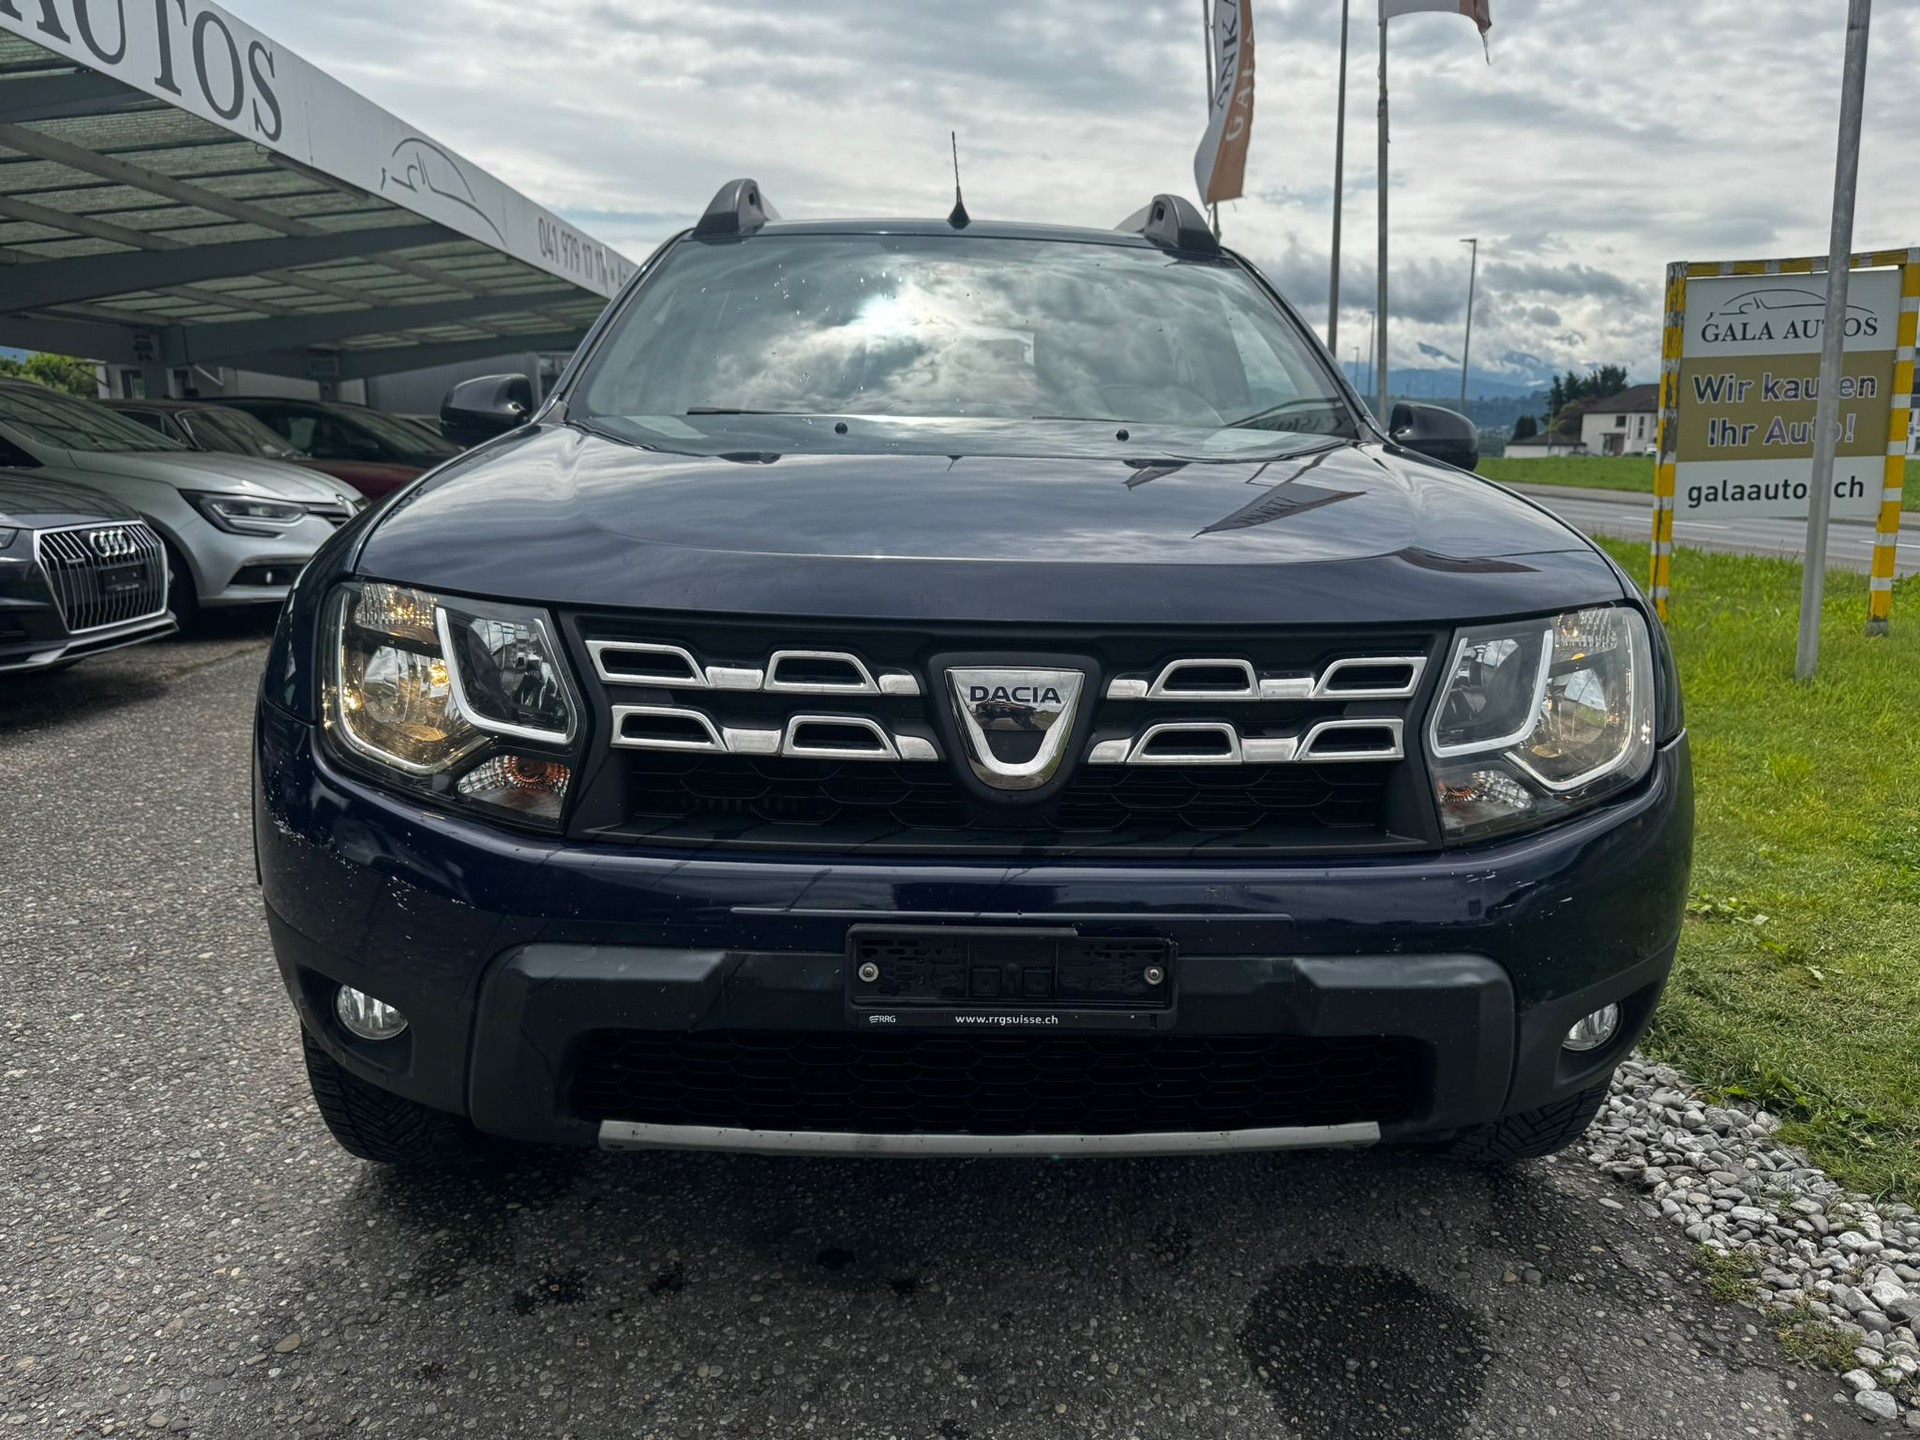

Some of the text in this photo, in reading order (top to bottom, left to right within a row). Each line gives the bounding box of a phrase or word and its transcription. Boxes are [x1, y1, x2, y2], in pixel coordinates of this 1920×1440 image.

[1701, 316, 1878, 343] GALA AUOS
[1693, 372, 1877, 403] Wir kauen
[1708, 417, 1758, 447] Ihr
[1687, 475, 1864, 508] galaautoch
[970, 685, 1061, 704] DACIA
[879, 1014, 1058, 1025] RRG www.rrgsuisse.ch
